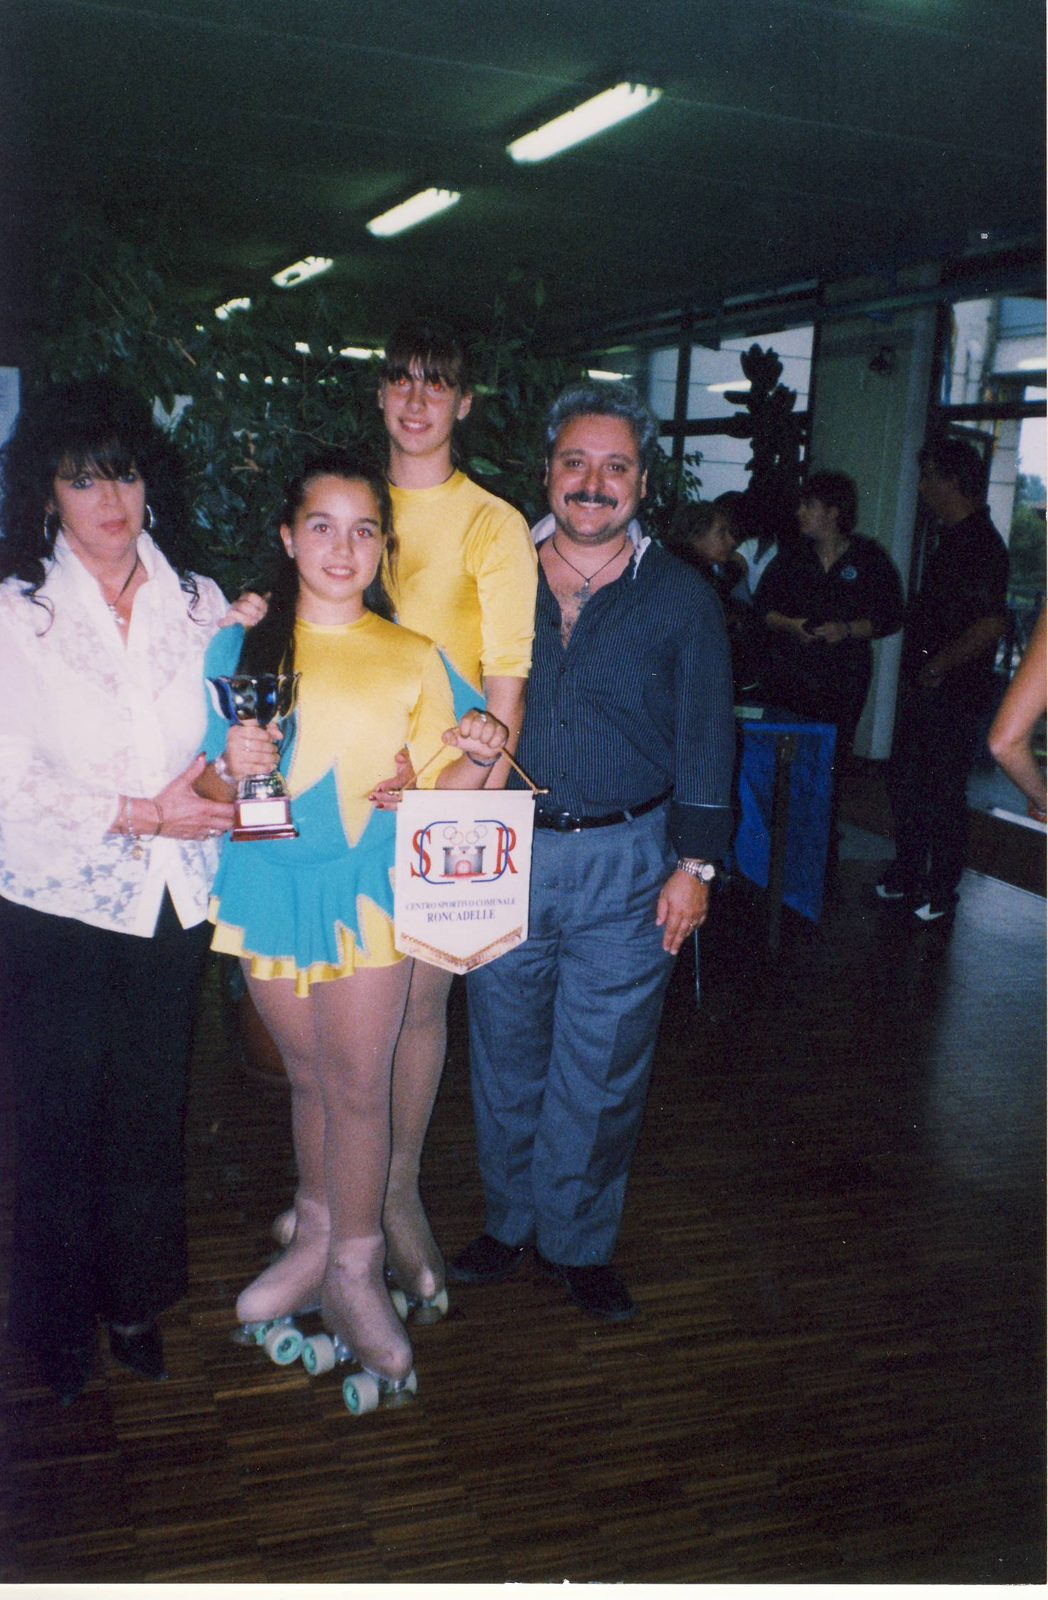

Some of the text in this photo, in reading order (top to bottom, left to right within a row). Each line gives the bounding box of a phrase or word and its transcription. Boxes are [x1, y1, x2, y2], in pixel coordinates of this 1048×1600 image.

[405, 897, 516, 911] CENTRO SPORTIVO COMUNALE
[427, 909, 495, 922] RONCADELLE
